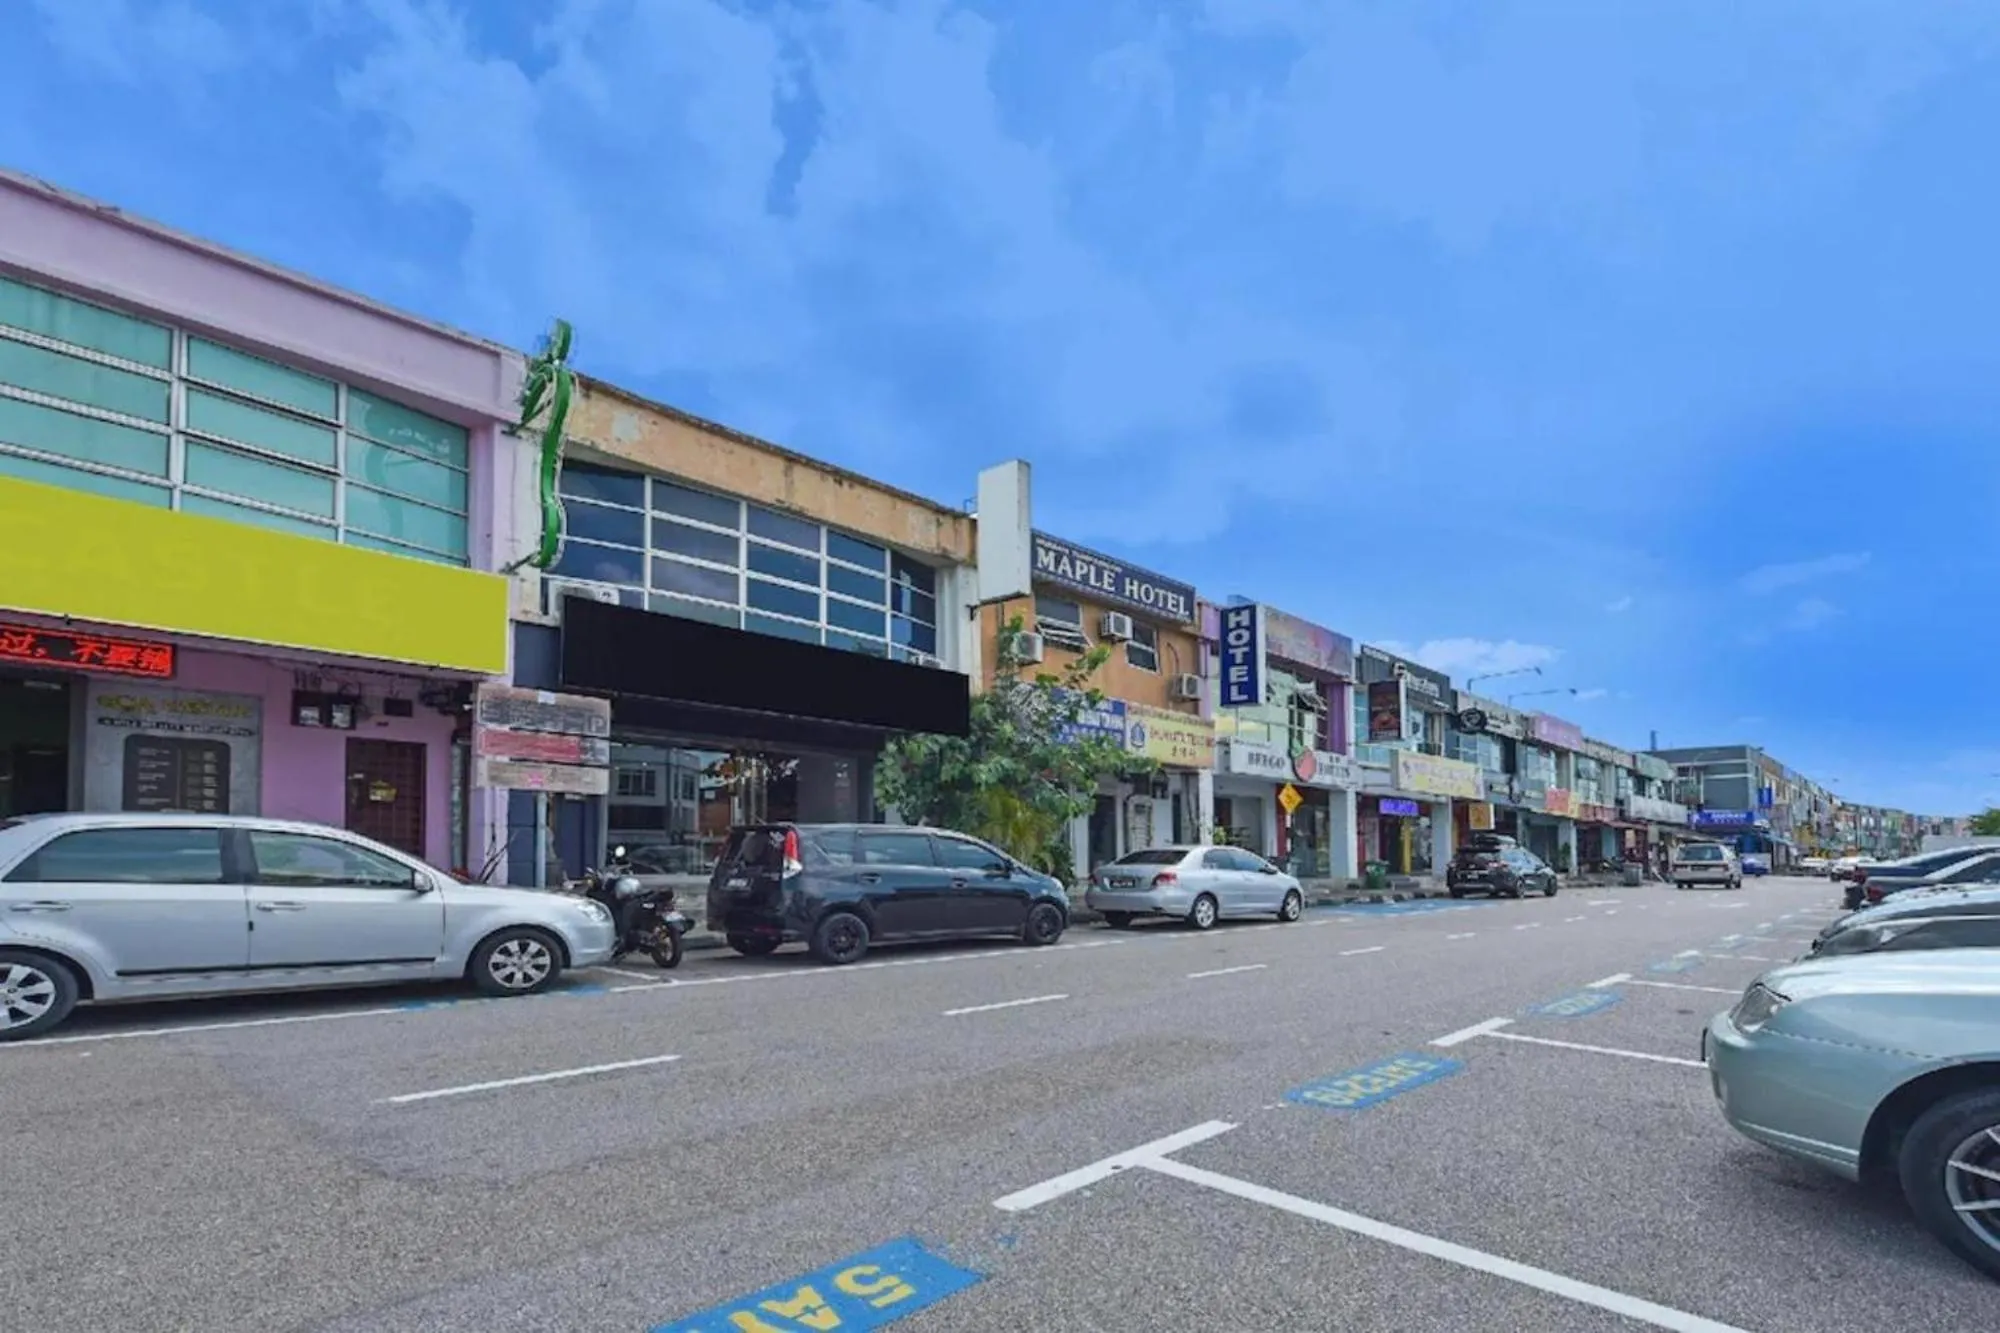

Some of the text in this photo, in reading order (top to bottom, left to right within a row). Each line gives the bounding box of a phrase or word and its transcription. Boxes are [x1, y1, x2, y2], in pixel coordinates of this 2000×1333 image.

[1036, 545, 1117, 591] MAPLE
[1124, 576, 1190, 616] HOTEL
[1227, 609, 1250, 702] HOTEL
